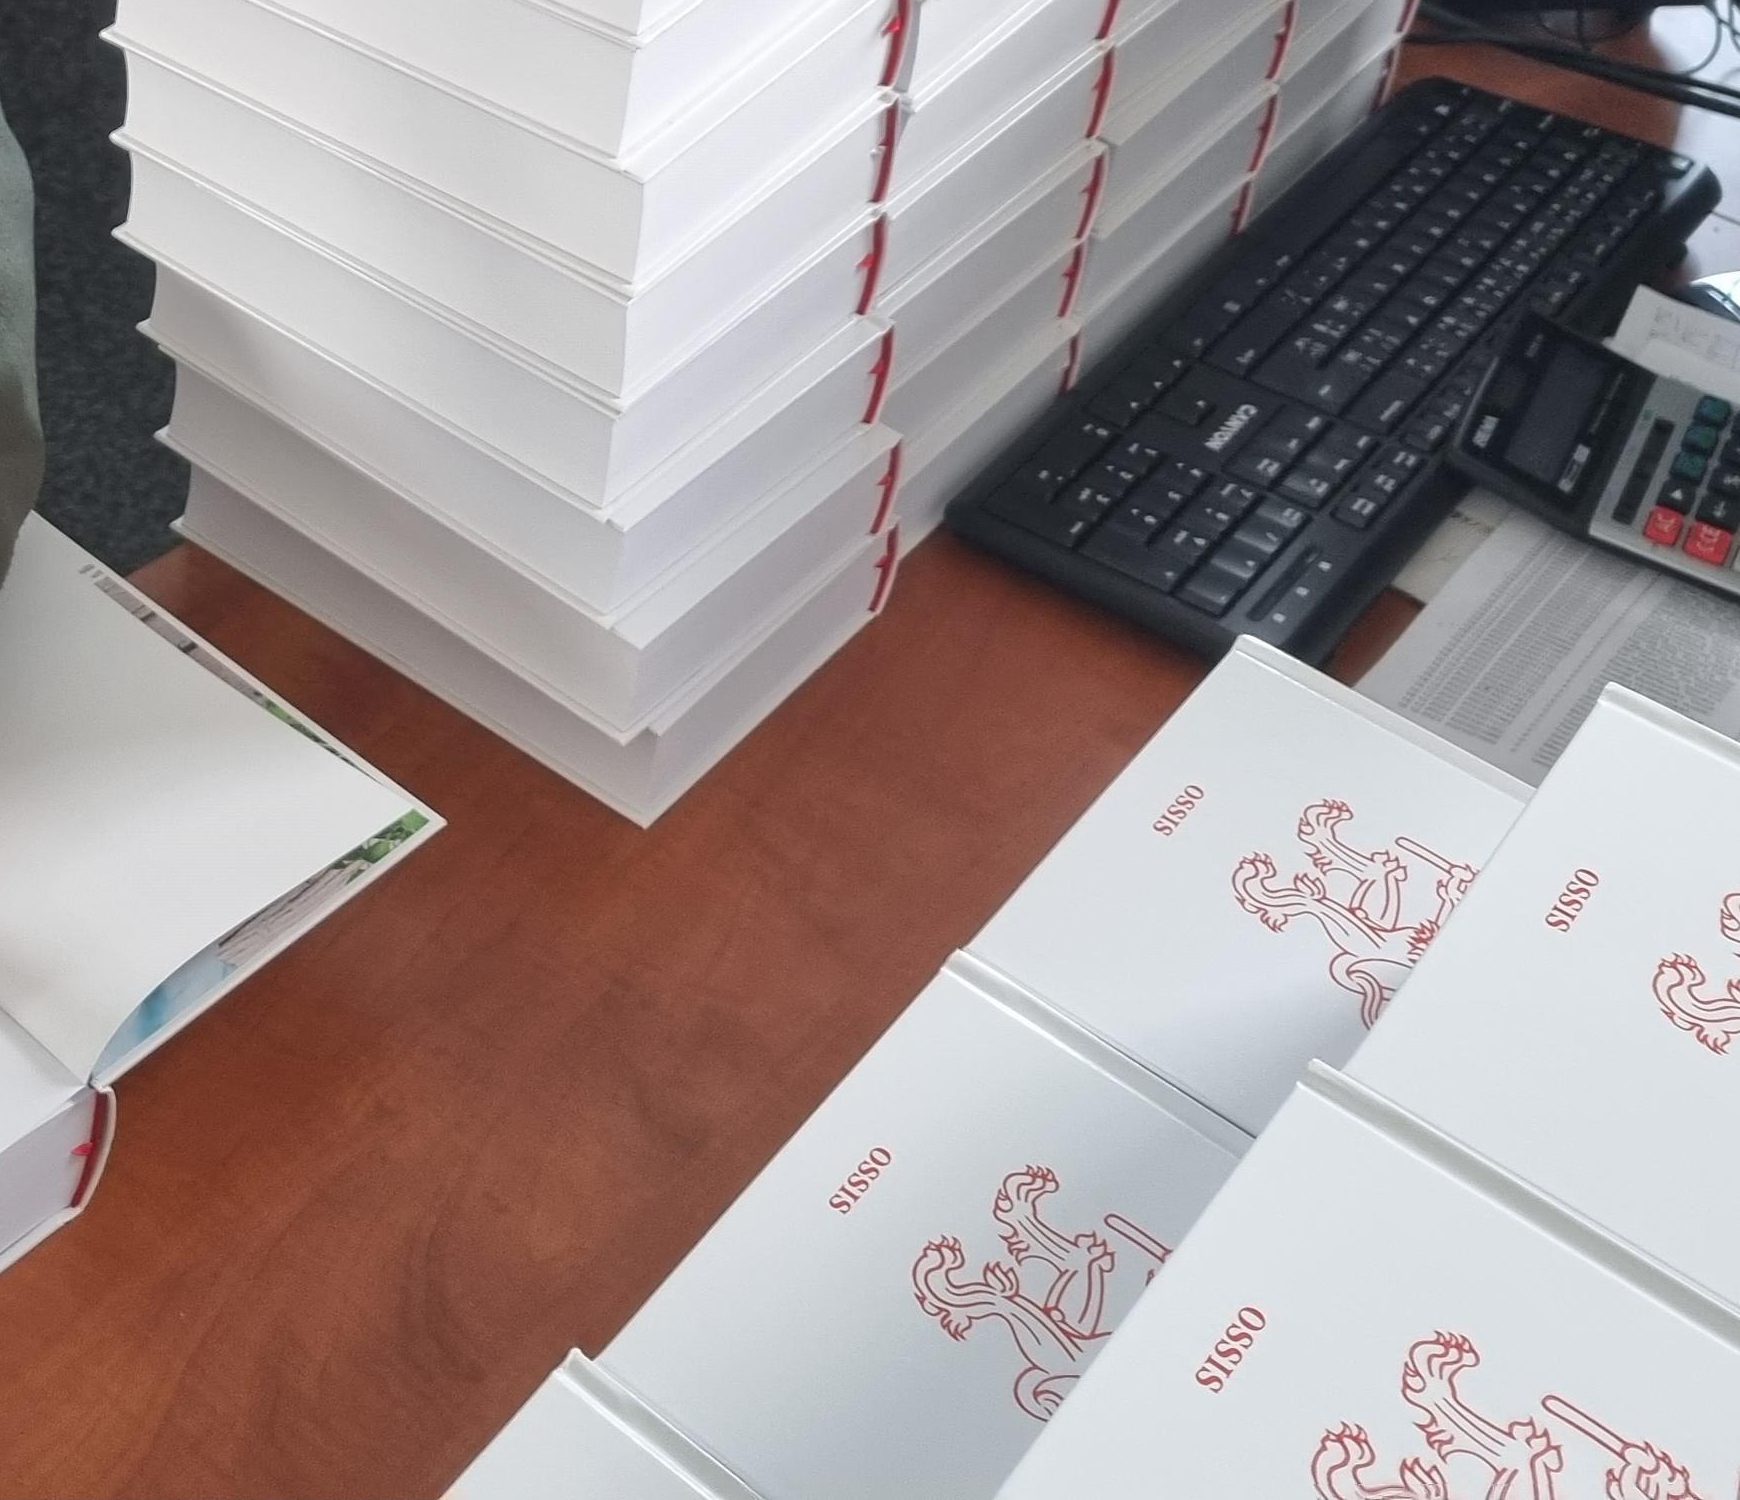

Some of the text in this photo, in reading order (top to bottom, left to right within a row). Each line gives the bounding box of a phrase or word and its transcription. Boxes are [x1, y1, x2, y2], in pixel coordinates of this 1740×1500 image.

[1204, 404, 1258, 452] CANYON
[1153, 784, 1205, 836] OSSIS
[1544, 867, 1600, 932] OSSIS
[827, 1145, 893, 1214] OSSIS
[1195, 1304, 1268, 1393] OSSIS
